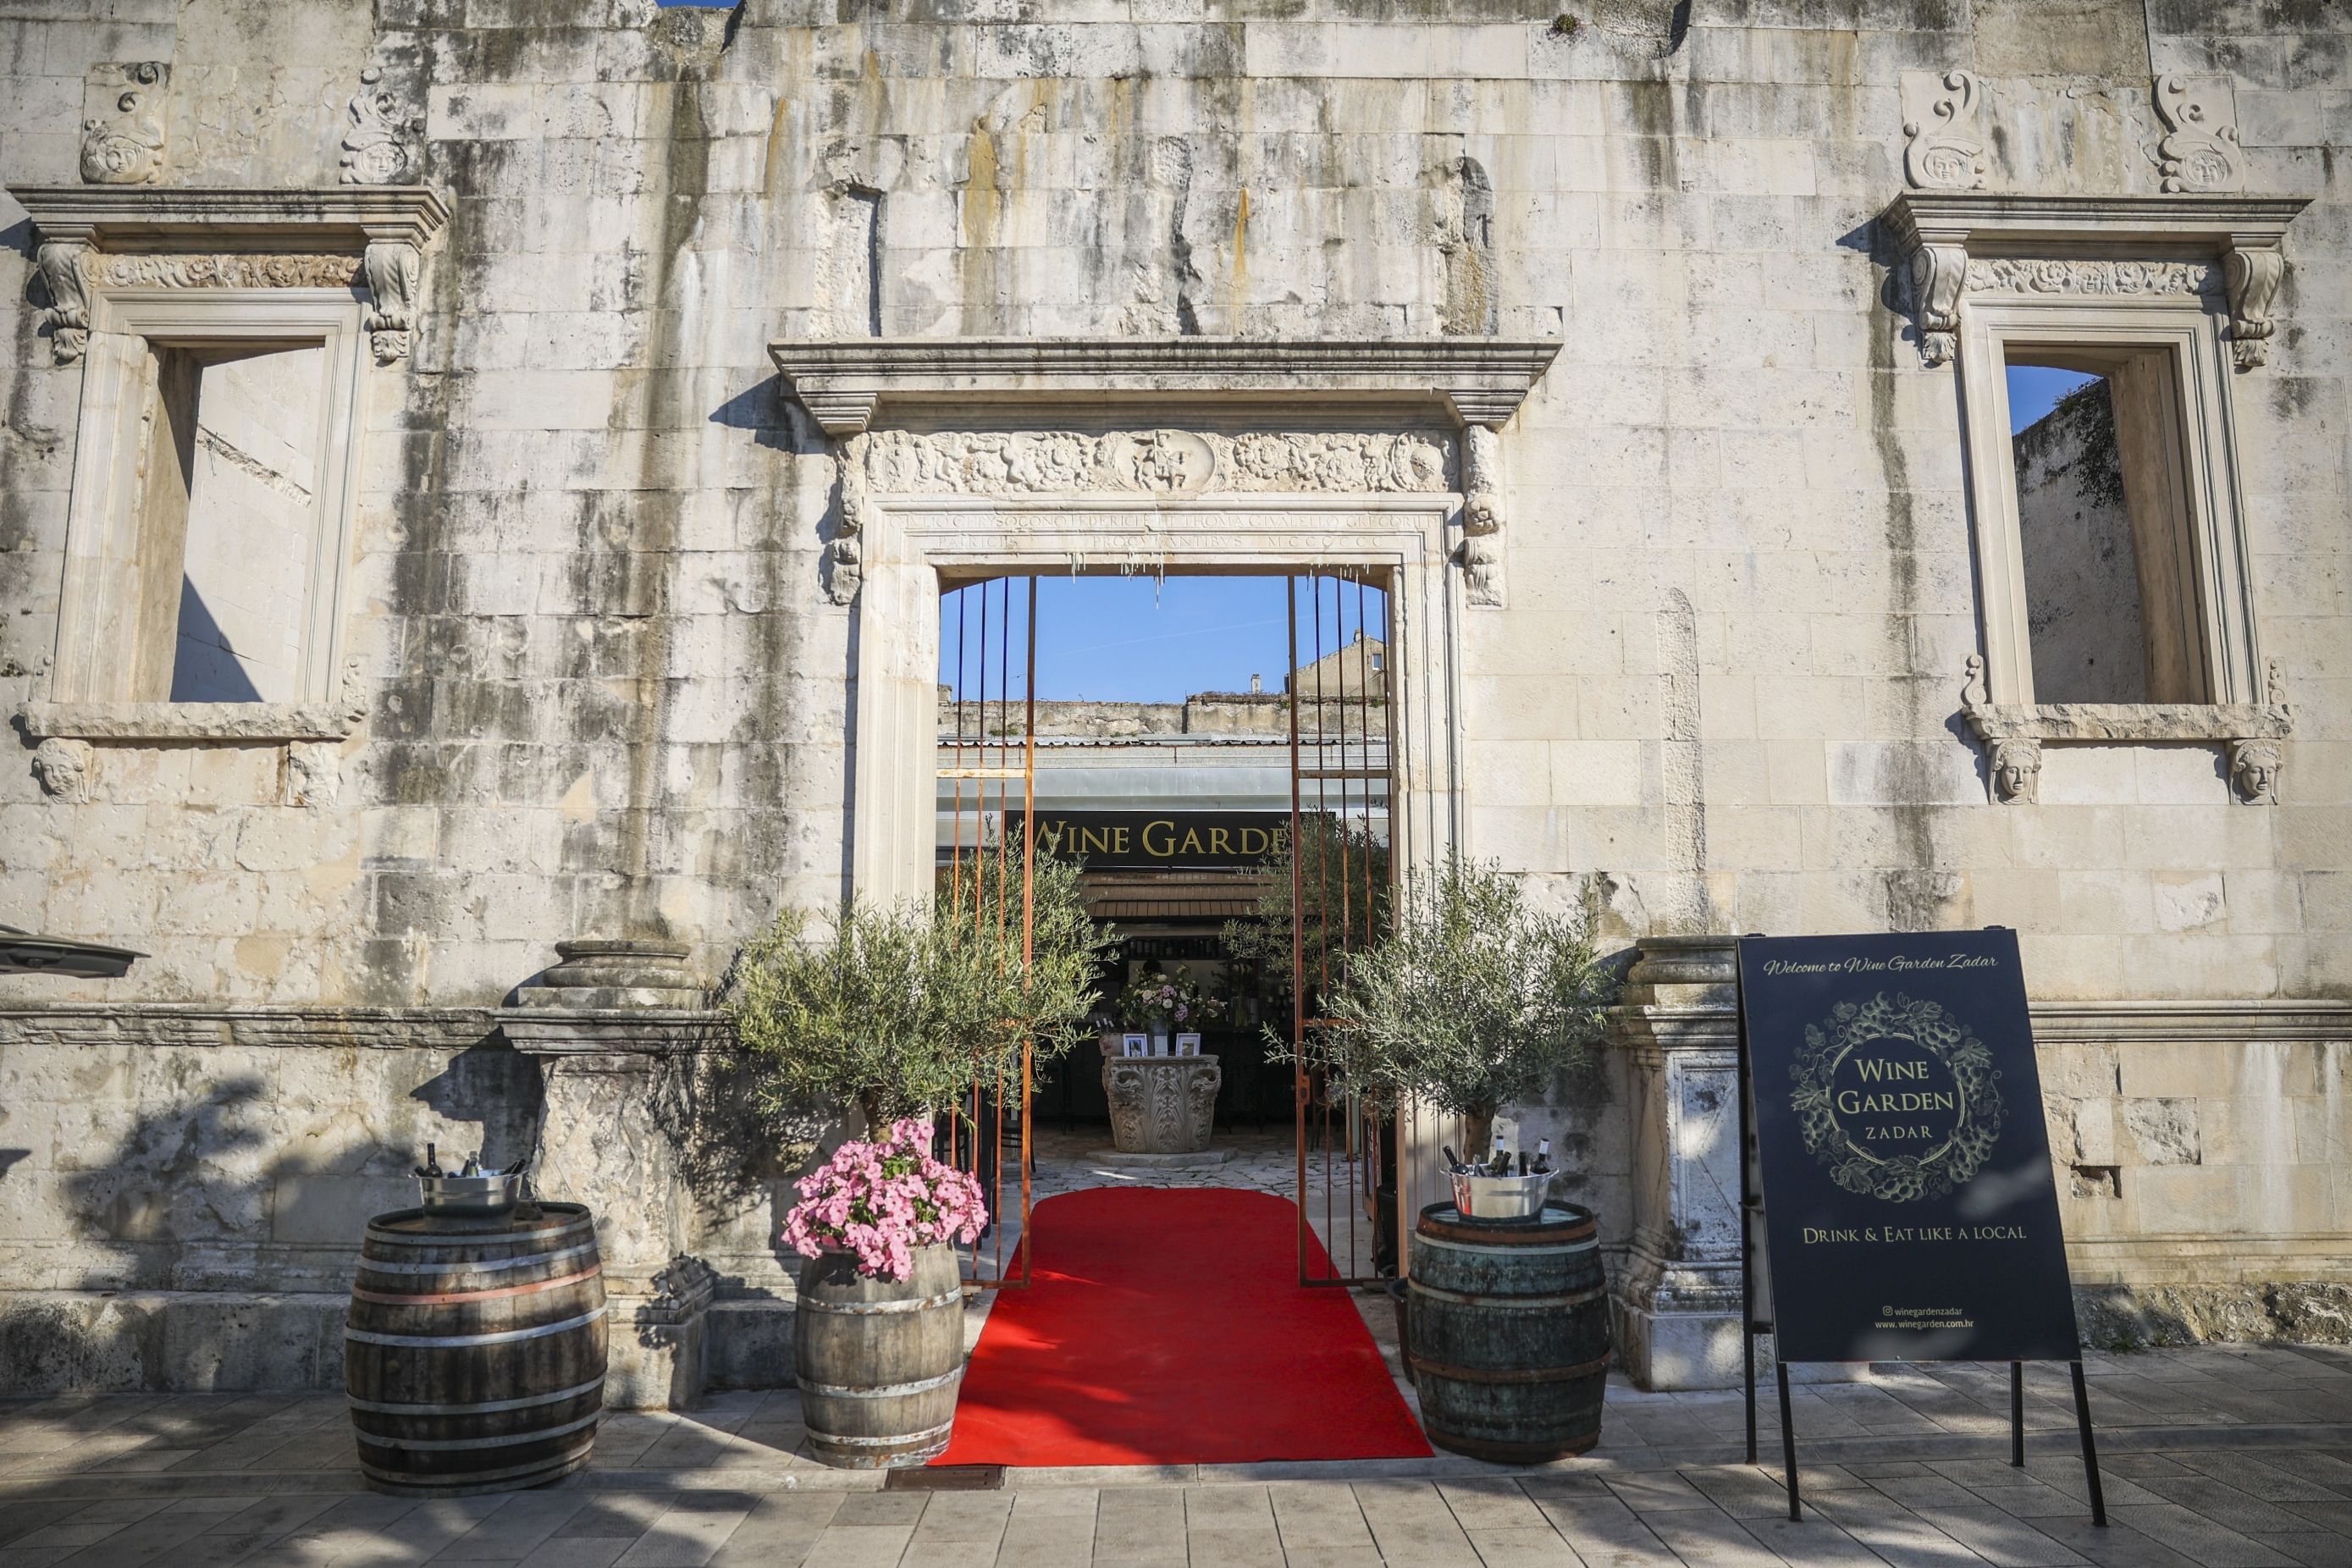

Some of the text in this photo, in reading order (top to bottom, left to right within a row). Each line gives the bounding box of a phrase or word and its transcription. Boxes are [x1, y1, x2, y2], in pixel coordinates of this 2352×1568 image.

[1142, 820, 1294, 857] GARDE
[1763, 953, 1999, 975] Welcome to Wine Garden Zadar
[1865, 1124, 1934, 1140] ZADAR
[1864, 1227, 1879, 1242] &
[1919, 1227, 1952, 1241] LIKE
[1957, 1227, 1969, 1240] A
[1973, 1226, 2028, 1240] LOCAL
[1894, 1307, 1963, 1318] winegardenzadar
